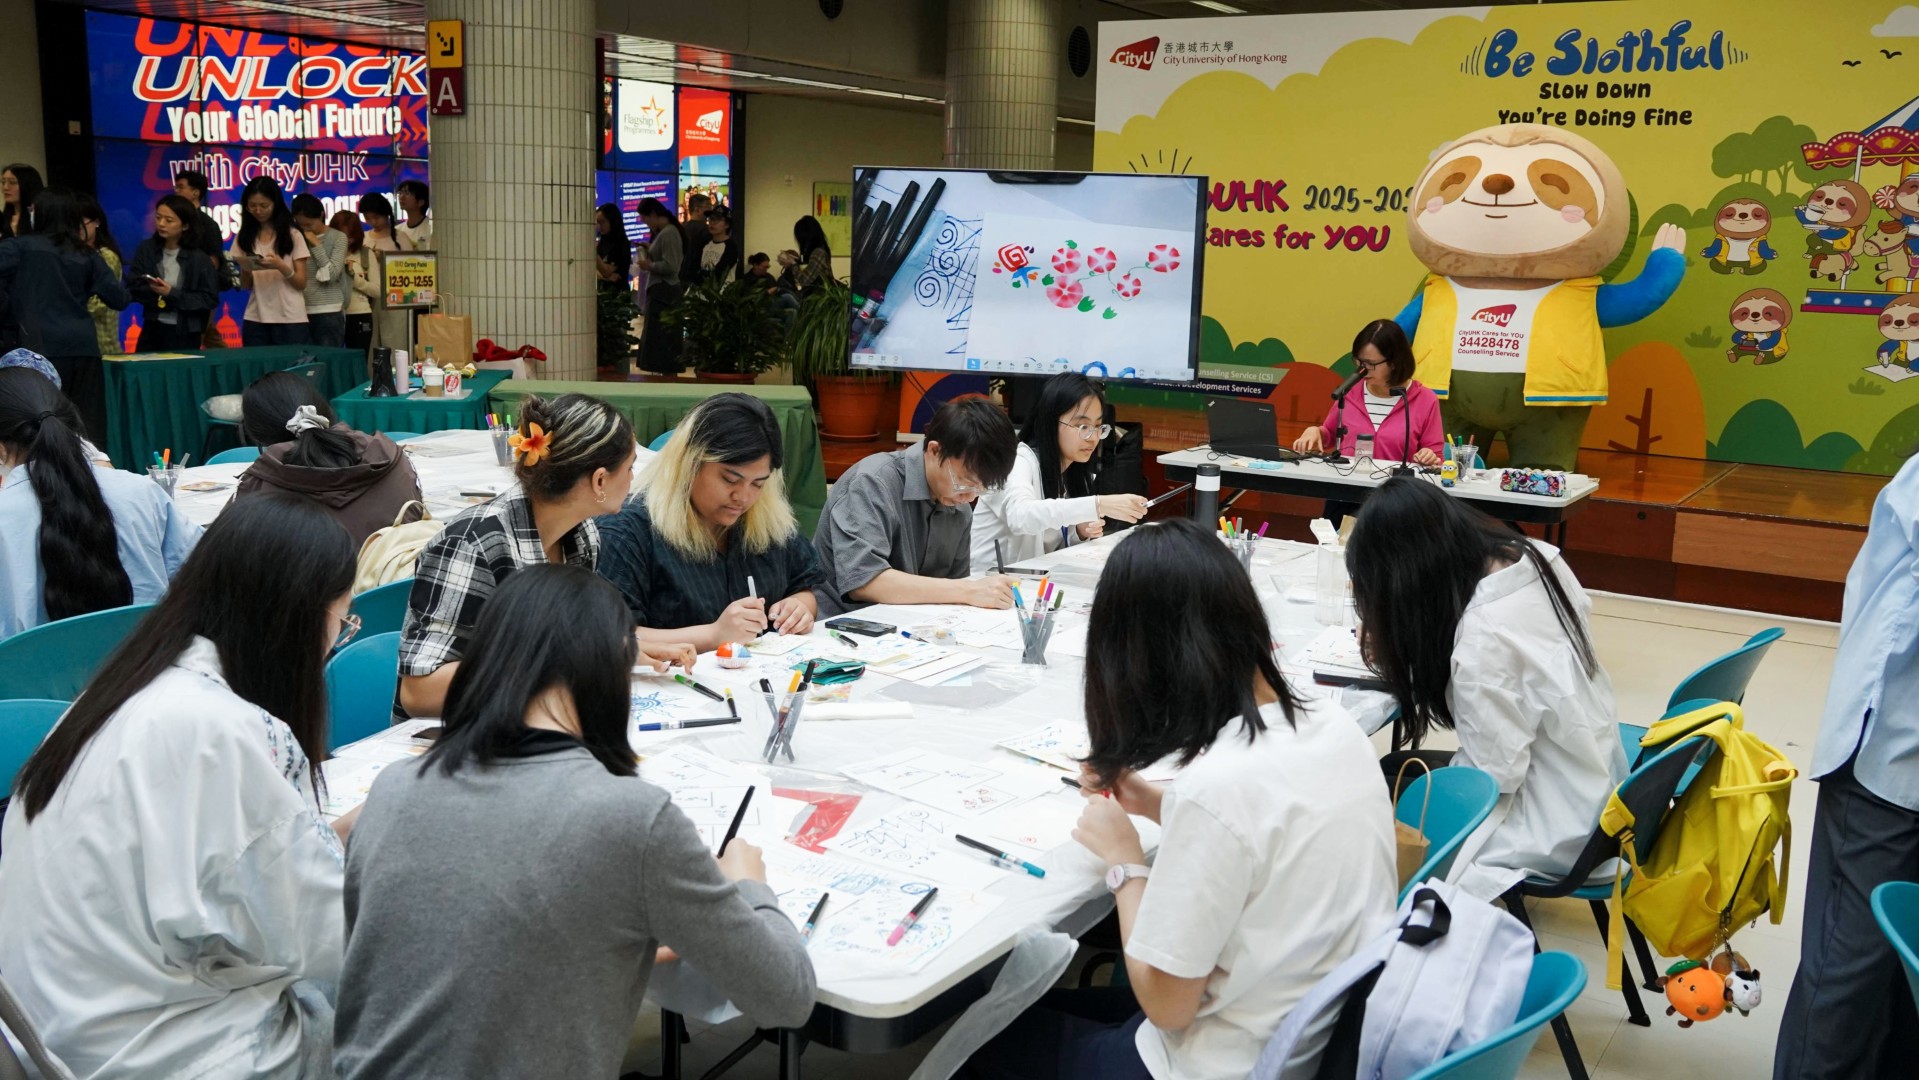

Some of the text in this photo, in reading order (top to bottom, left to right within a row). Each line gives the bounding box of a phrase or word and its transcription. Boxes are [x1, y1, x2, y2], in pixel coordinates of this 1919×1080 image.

[1164, 41, 1234, 54] 香港城市大學
[1484, 19, 1724, 78] Be Slothful
[1115, 51, 1154, 68] CityU
[1163, 53, 1288, 66] City University of Hong Kong
[132, 56, 427, 102] UNLOCK
[437, 76, 458, 107] A
[167, 102, 401, 143] Your Global Future
[624, 114, 654, 128] Flagship
[700, 118, 720, 132] CityU
[1498, 107, 1692, 128] You're Doing Fine
[170, 151, 369, 191] with CityUHK
[1208, 179, 1289, 213] UHK
[1207, 224, 1390, 252] ares for YOU
[1475, 311, 1511, 325] CityU
[1459, 336, 1520, 350] 34428478
[1458, 348, 1520, 357] Counselling Service
[1231, 371, 1257, 380] Service
[1259, 373, 1274, 383] (CS)
[1231, 383, 1262, 394] Services
